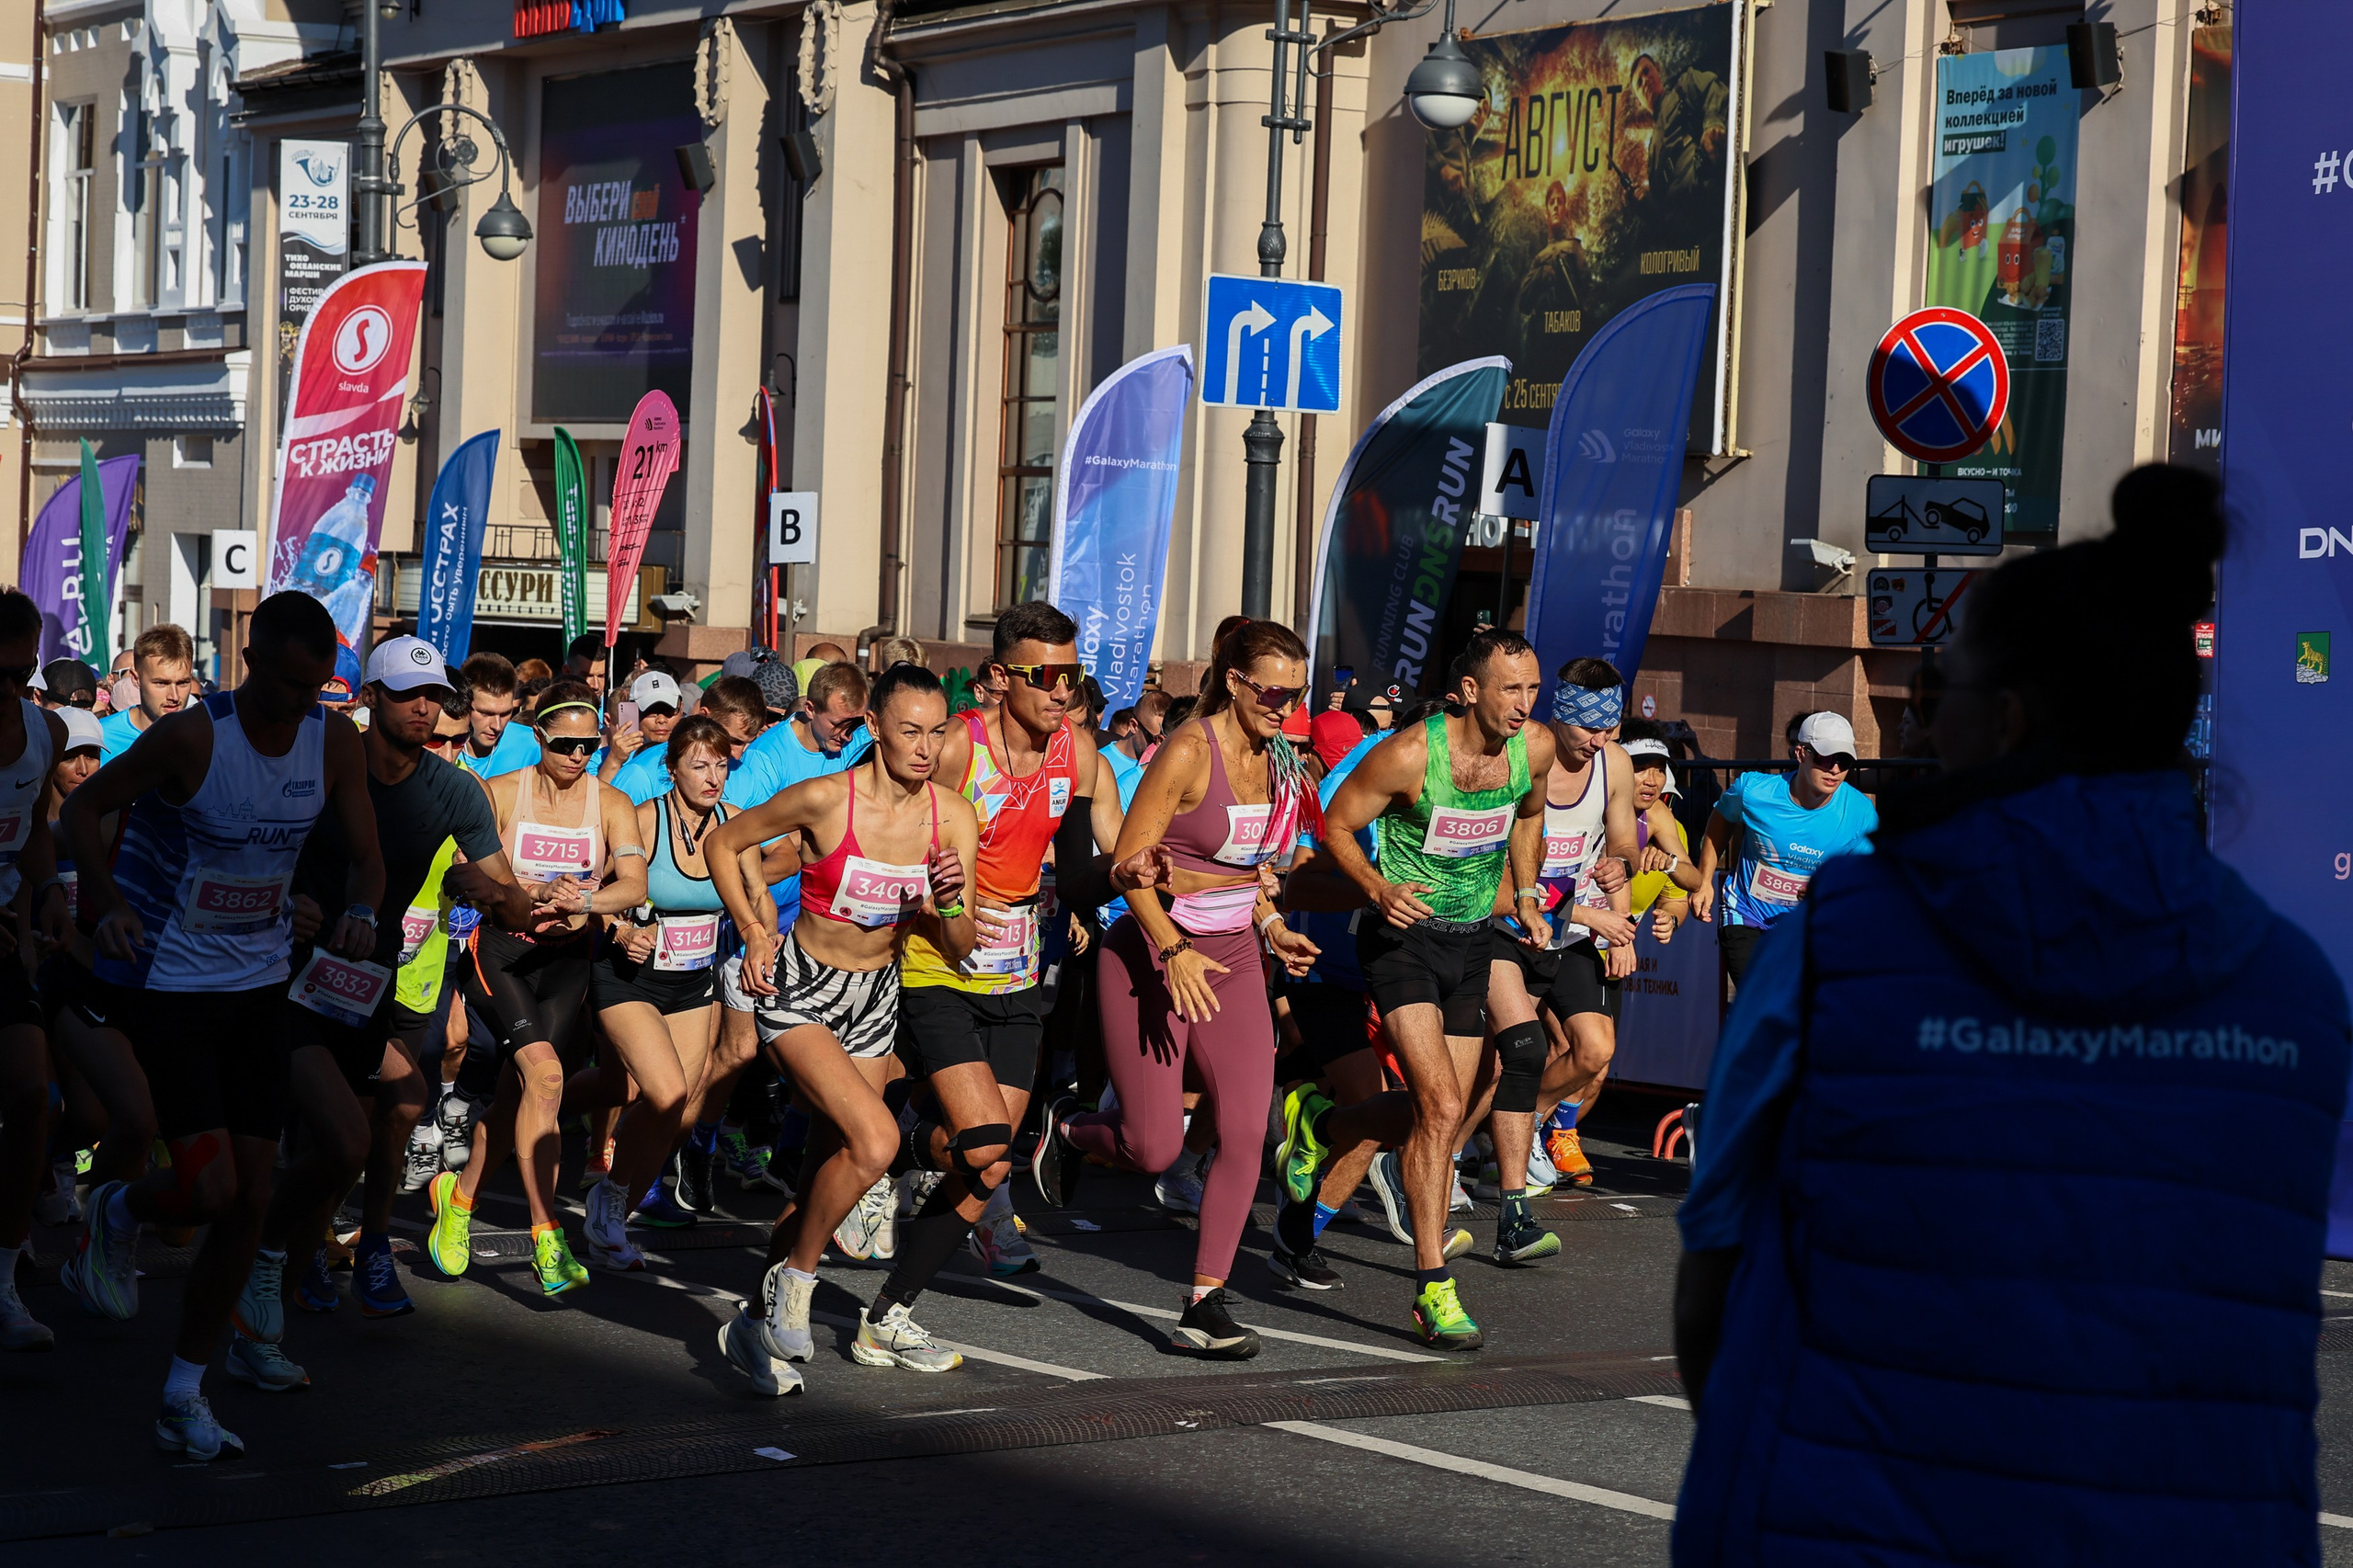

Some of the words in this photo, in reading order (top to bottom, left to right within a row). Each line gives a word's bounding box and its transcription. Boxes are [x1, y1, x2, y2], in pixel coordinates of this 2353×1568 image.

[1947, 85, 1995, 106] Вперёд
[1998, 86, 2013, 100] за
[2017, 78, 2057, 98] новой
[1945, 106, 2025, 129] коллекцией
[1501, 85, 1623, 181] АВГУСТ
[1944, 131, 2006, 154] игрушек!
[289, 194, 339, 210] 23-28
[564, 180, 631, 224] ВЫБЕРИ
[289, 210, 338, 221] СЕНТЯБРЯ
[593, 222, 679, 269] КИНОДЕНЬ
[284, 254, 310, 262] ТИХО
[1641, 246, 1700, 276] КОЛОГРИВЫЙ
[1438, 268, 1477, 292] БЕЗРУКОВ
[1544, 310, 1581, 334] ТАБАКОВ
[337, 381, 369, 393] slavda
[1513, 378, 1528, 409] 25
[290, 427, 395, 465] СТРАСТЬ
[317, 447, 390, 476] ЖИЗНИ
[632, 444, 654, 480] 21
[1085, 455, 1177, 472] #GalaxyMarathon
[1495, 447, 1535, 497] A
[1957, 467, 1985, 477] ВКУСНО
[779, 508, 801, 545] B
[224, 544, 246, 574] C
[1102, 551, 1138, 699] Vladivostok
[1122, 583, 1154, 700] Marathon
[246, 827, 292, 845] RUN
[1443, 820, 1499, 836] 3806
[532, 839, 580, 859] 3715
[1789, 842, 1824, 858] Galaxy
[210, 888, 273, 909] 3862
[855, 877, 917, 902] 3409
[673, 927, 711, 948] 3144
[318, 965, 372, 998] 3832
[1643, 978, 1679, 996] ТЕХНИКА
[1917, 1017, 2298, 1068] #GalaxyMarathon
